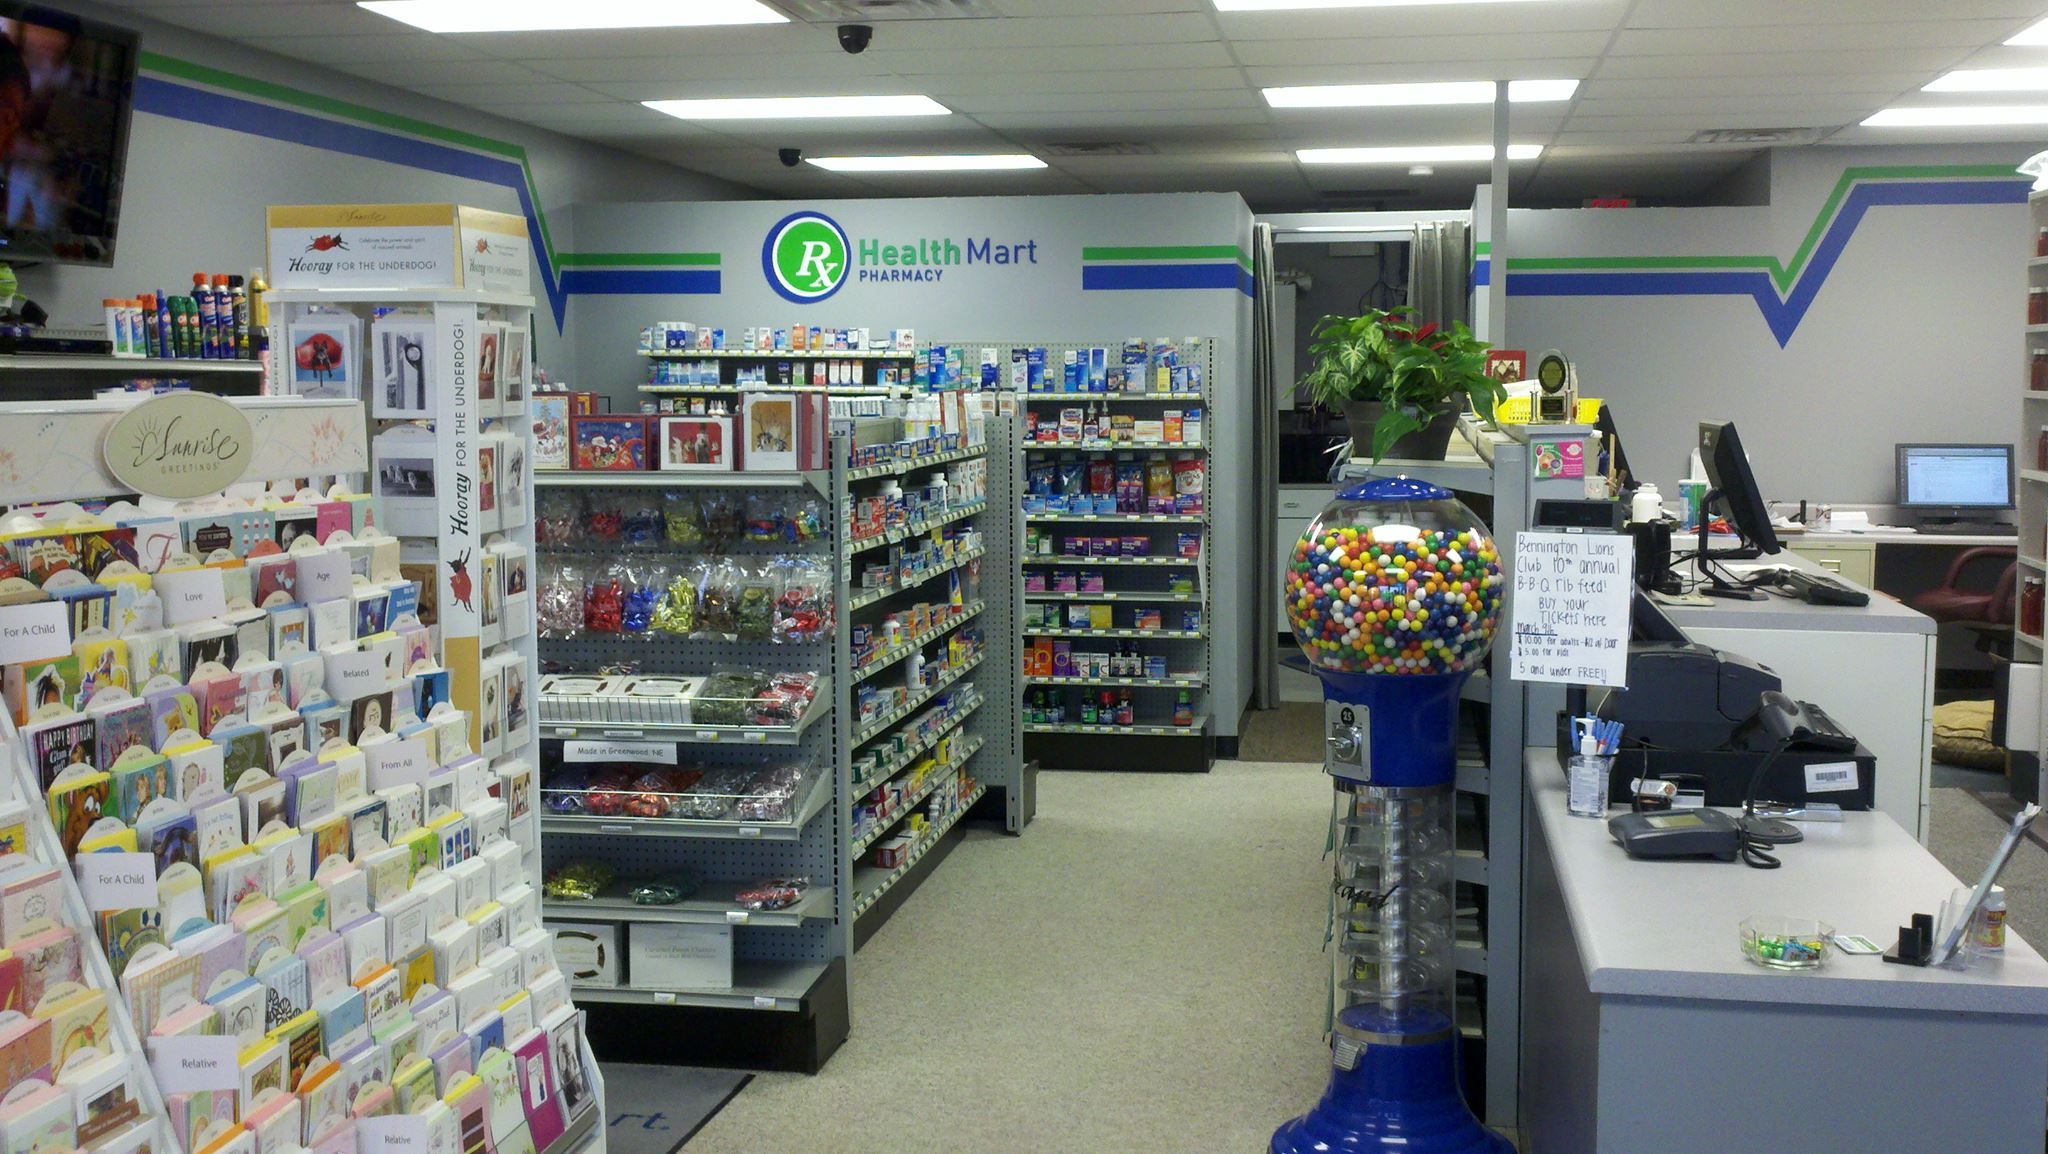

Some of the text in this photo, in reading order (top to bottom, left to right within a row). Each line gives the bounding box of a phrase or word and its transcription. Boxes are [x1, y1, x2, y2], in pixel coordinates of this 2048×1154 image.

[858, 237, 1037, 266] Health Mart
[289, 257, 437, 275] Hooray FOR THE UNDERDOG!
[859, 269, 943, 283] PHARMACY
[450, 323, 471, 536] Hooray FOR THE UNDERDOG!
[148, 415, 239, 463] Sunrise
[161, 463, 217, 474] GREETINGS
[1518, 535, 1614, 556] Bennington Lions
[1517, 556, 1541, 573] Club
[1580, 558, 1620, 574] annual
[316, 572, 330, 581] Age
[1556, 577, 1573, 591] rib
[1578, 579, 1607, 594] feed!
[185, 593, 203, 602] Love
[1583, 613, 1607, 627] here
[4, 624, 56, 637] For A Child
[343, 669, 369, 678] Belated
[1530, 664, 1544, 675] and
[1550, 666, 1572, 676] under
[1343, 711, 1352, 721] 25
[43, 730, 65, 750] HAPPY
[577, 747, 597, 755] Made
[381, 759, 412, 770] From All
[99, 874, 145, 885] For A Child
[182, 1059, 217, 1069] Relative
[384, 1135, 411, 1145] Relative
